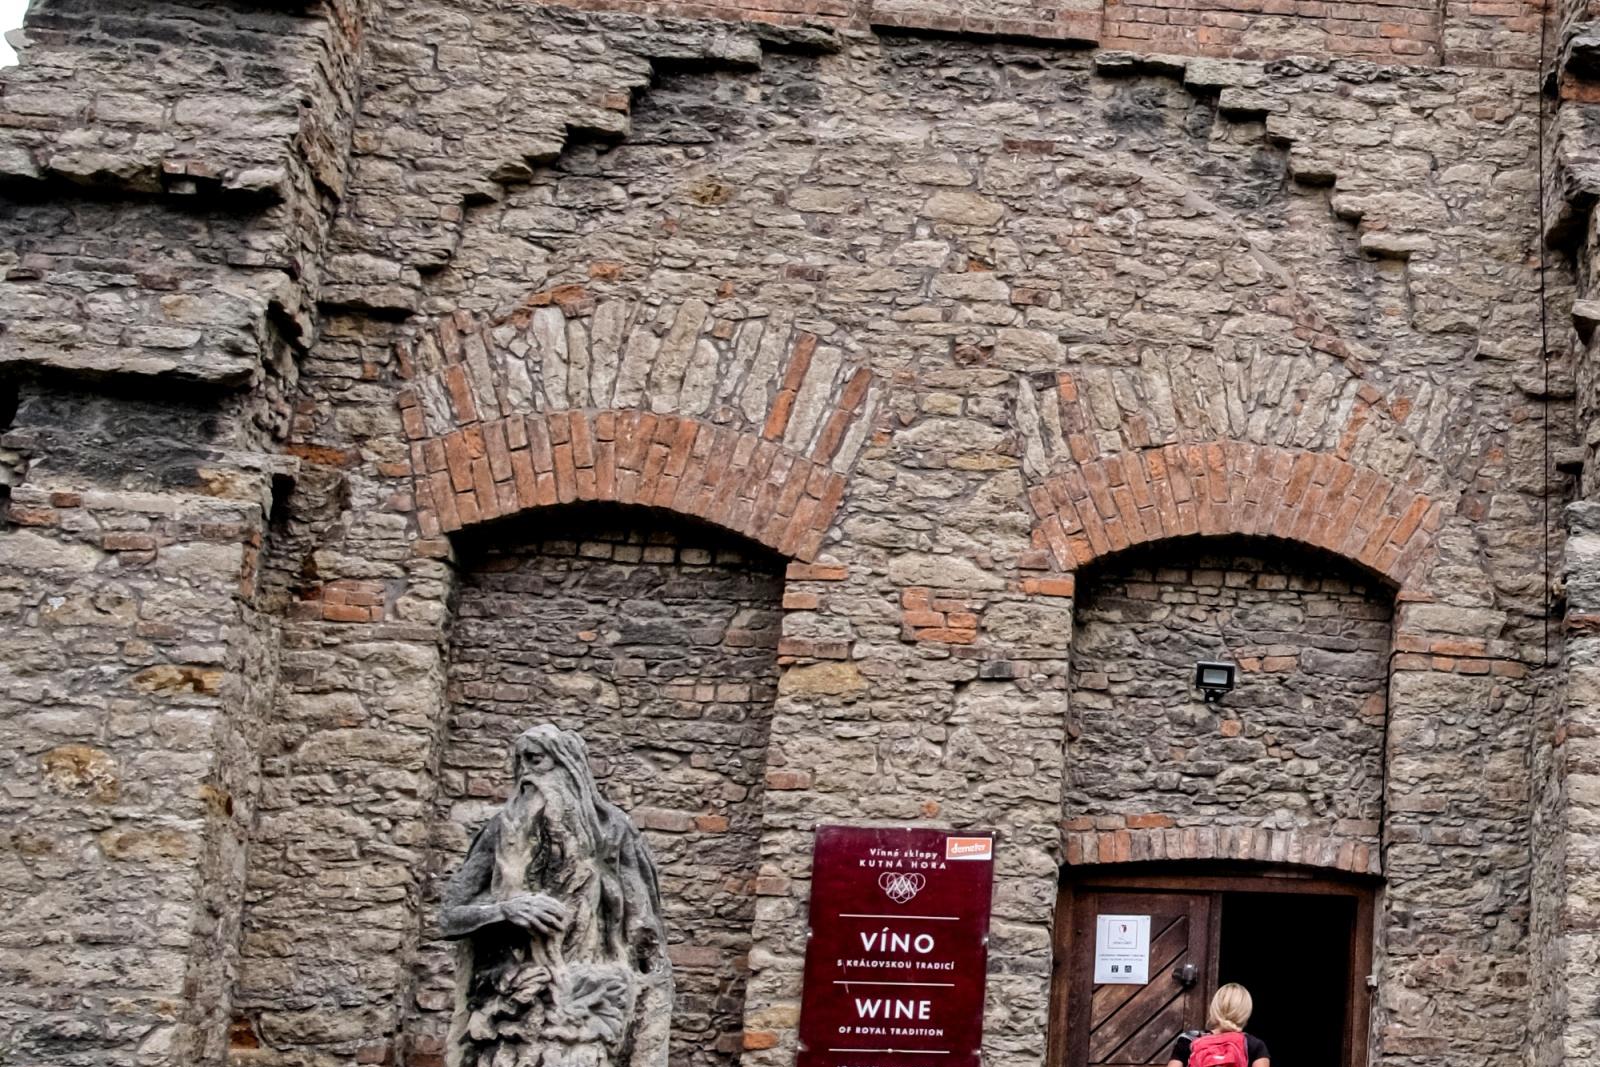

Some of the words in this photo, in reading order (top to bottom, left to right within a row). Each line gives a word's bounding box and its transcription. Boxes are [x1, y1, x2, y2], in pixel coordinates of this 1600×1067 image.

[870, 848, 899, 856] Vinné
[904, 850, 938, 859] sklepy
[951, 843, 986, 854] demeter
[860, 859, 902, 868] KUTNÁ
[912, 861, 946, 869] HORA
[860, 927, 934, 953] VÍNO
[847, 959, 912, 968] KRÁLOVSKOU
[916, 961, 955, 970] TRADICÍ
[855, 998, 931, 1019] WINE
[839, 1026, 851, 1034] OF
[856, 1027, 886, 1035] ROYAL
[890, 1028, 944, 1036] TRADITION
